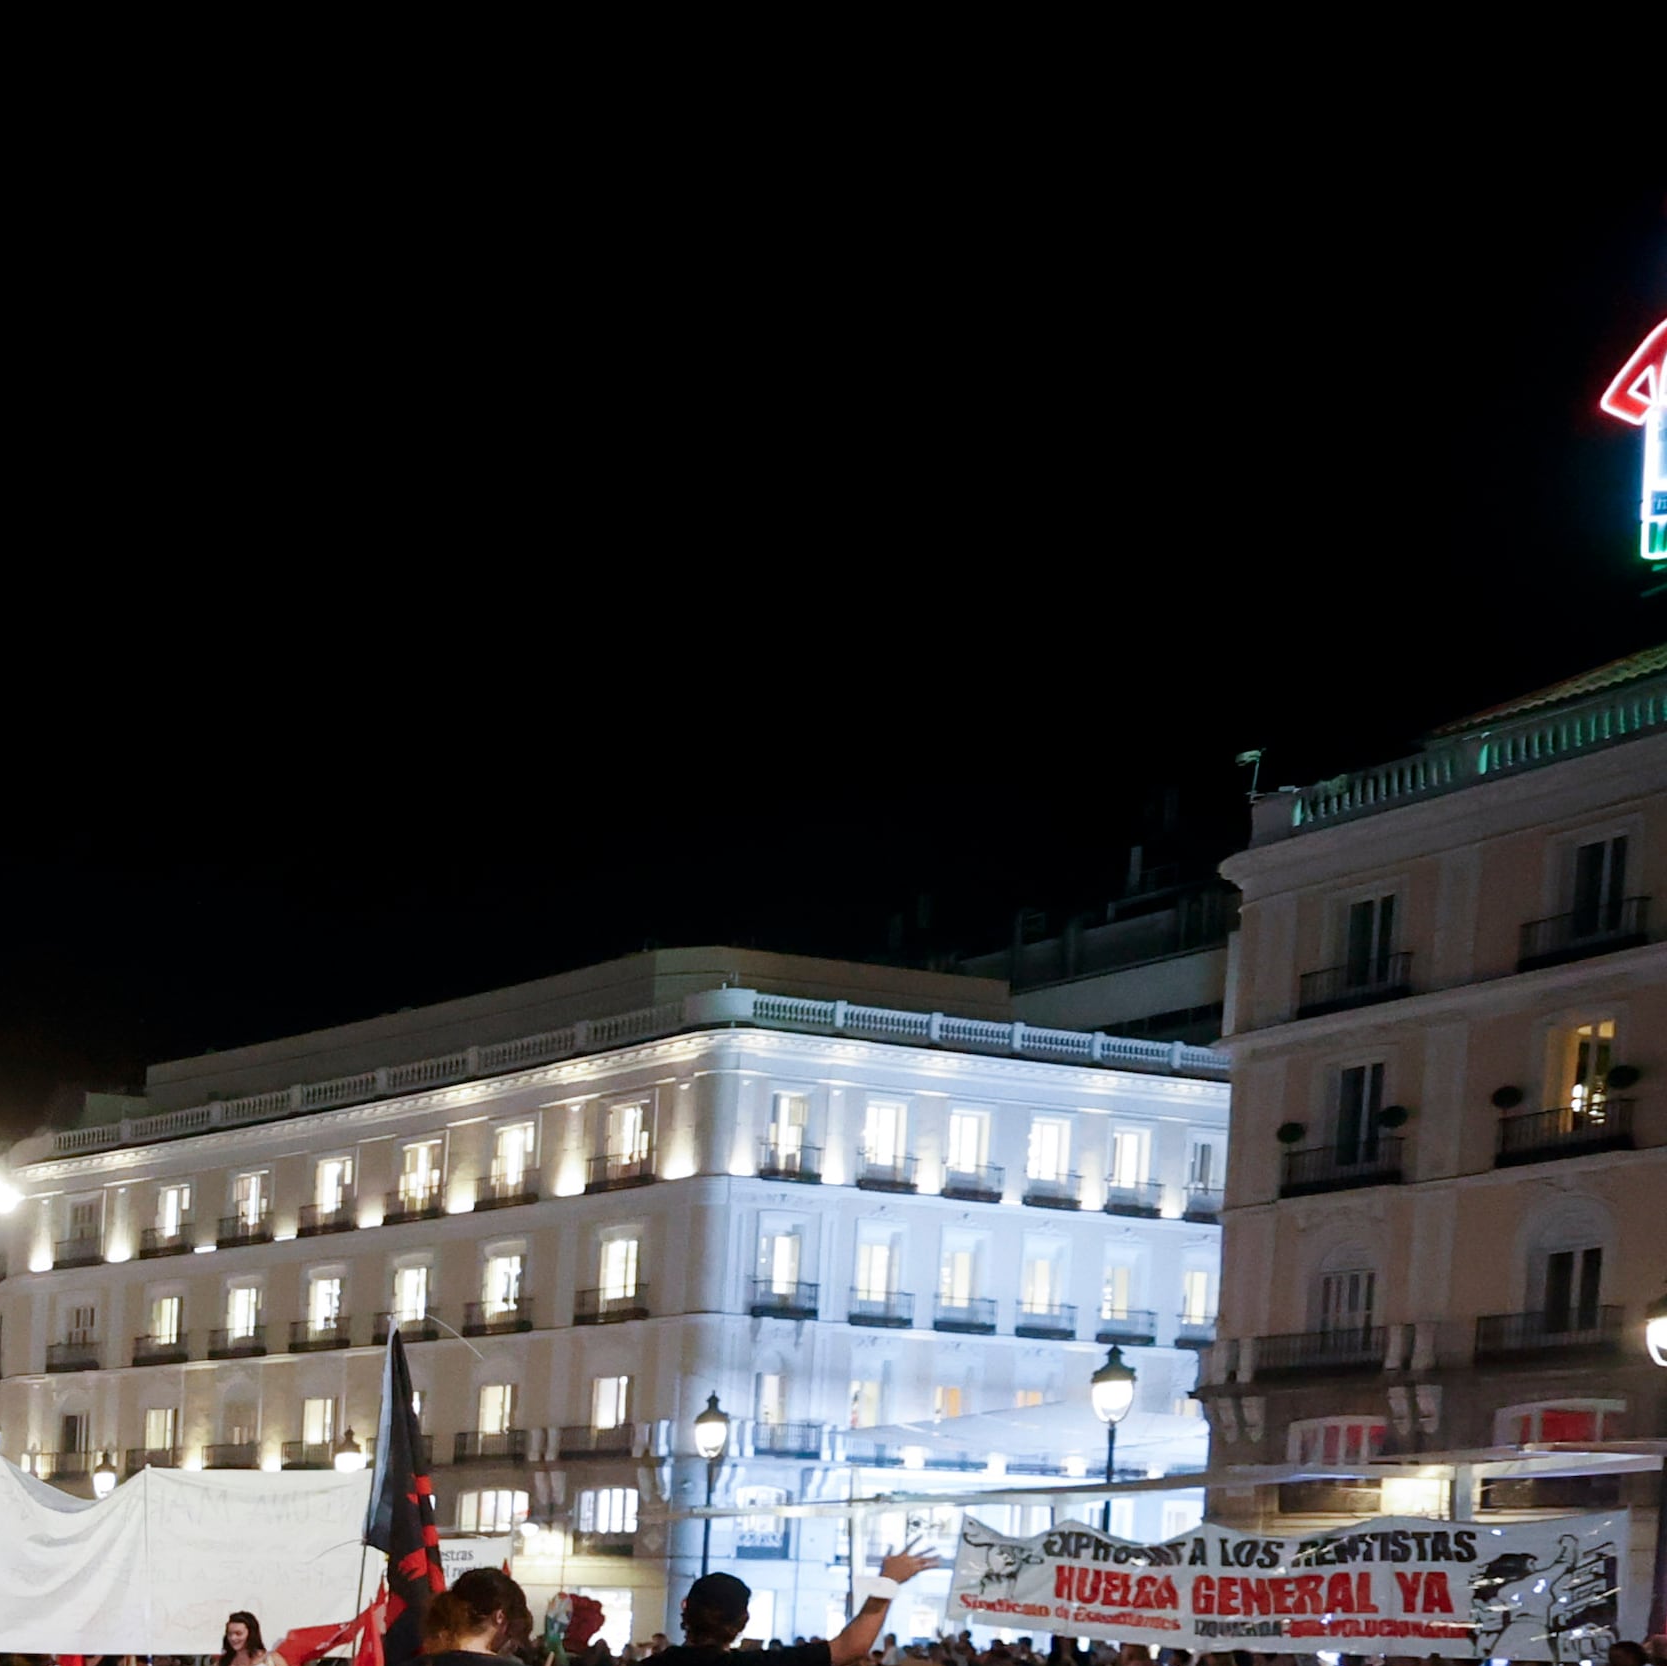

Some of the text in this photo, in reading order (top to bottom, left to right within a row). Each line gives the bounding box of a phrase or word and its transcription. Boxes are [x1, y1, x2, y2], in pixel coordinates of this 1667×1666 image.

[1188, 1537, 1208, 1566] A
[1220, 1538, 1285, 1569] LOS
[1291, 1530, 1477, 1568] RENTISTAS
[1054, 1565, 1454, 1617] HUELGA GENERAL YA
